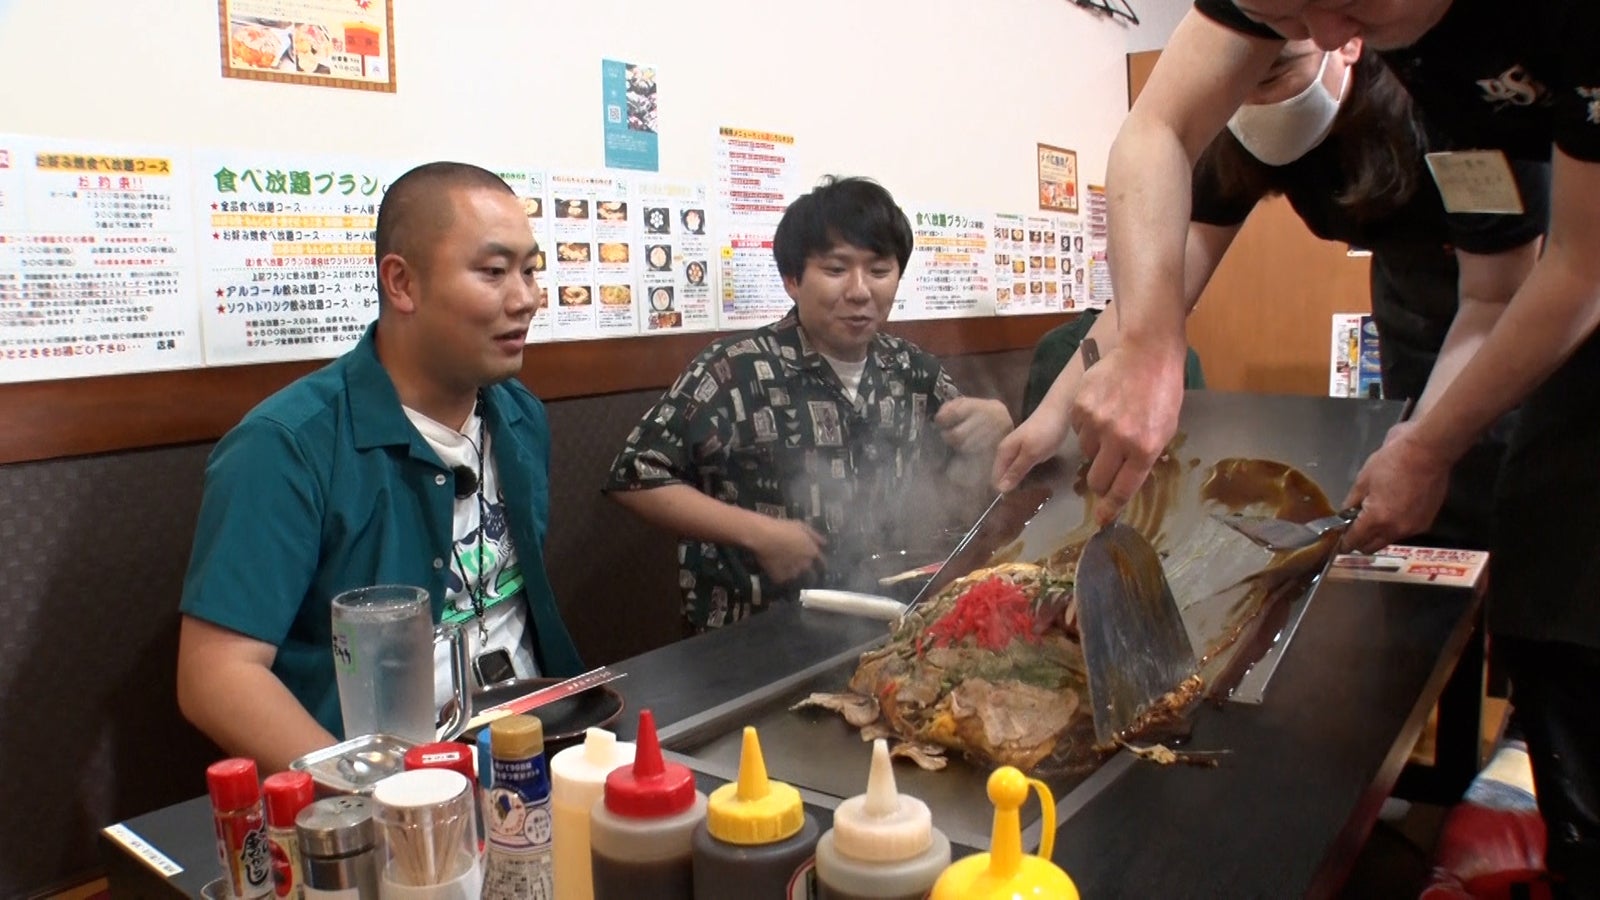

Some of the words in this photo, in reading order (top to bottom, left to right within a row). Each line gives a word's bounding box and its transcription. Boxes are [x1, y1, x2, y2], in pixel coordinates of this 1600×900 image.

[214, 166, 378, 196] 食べ放題プラン
